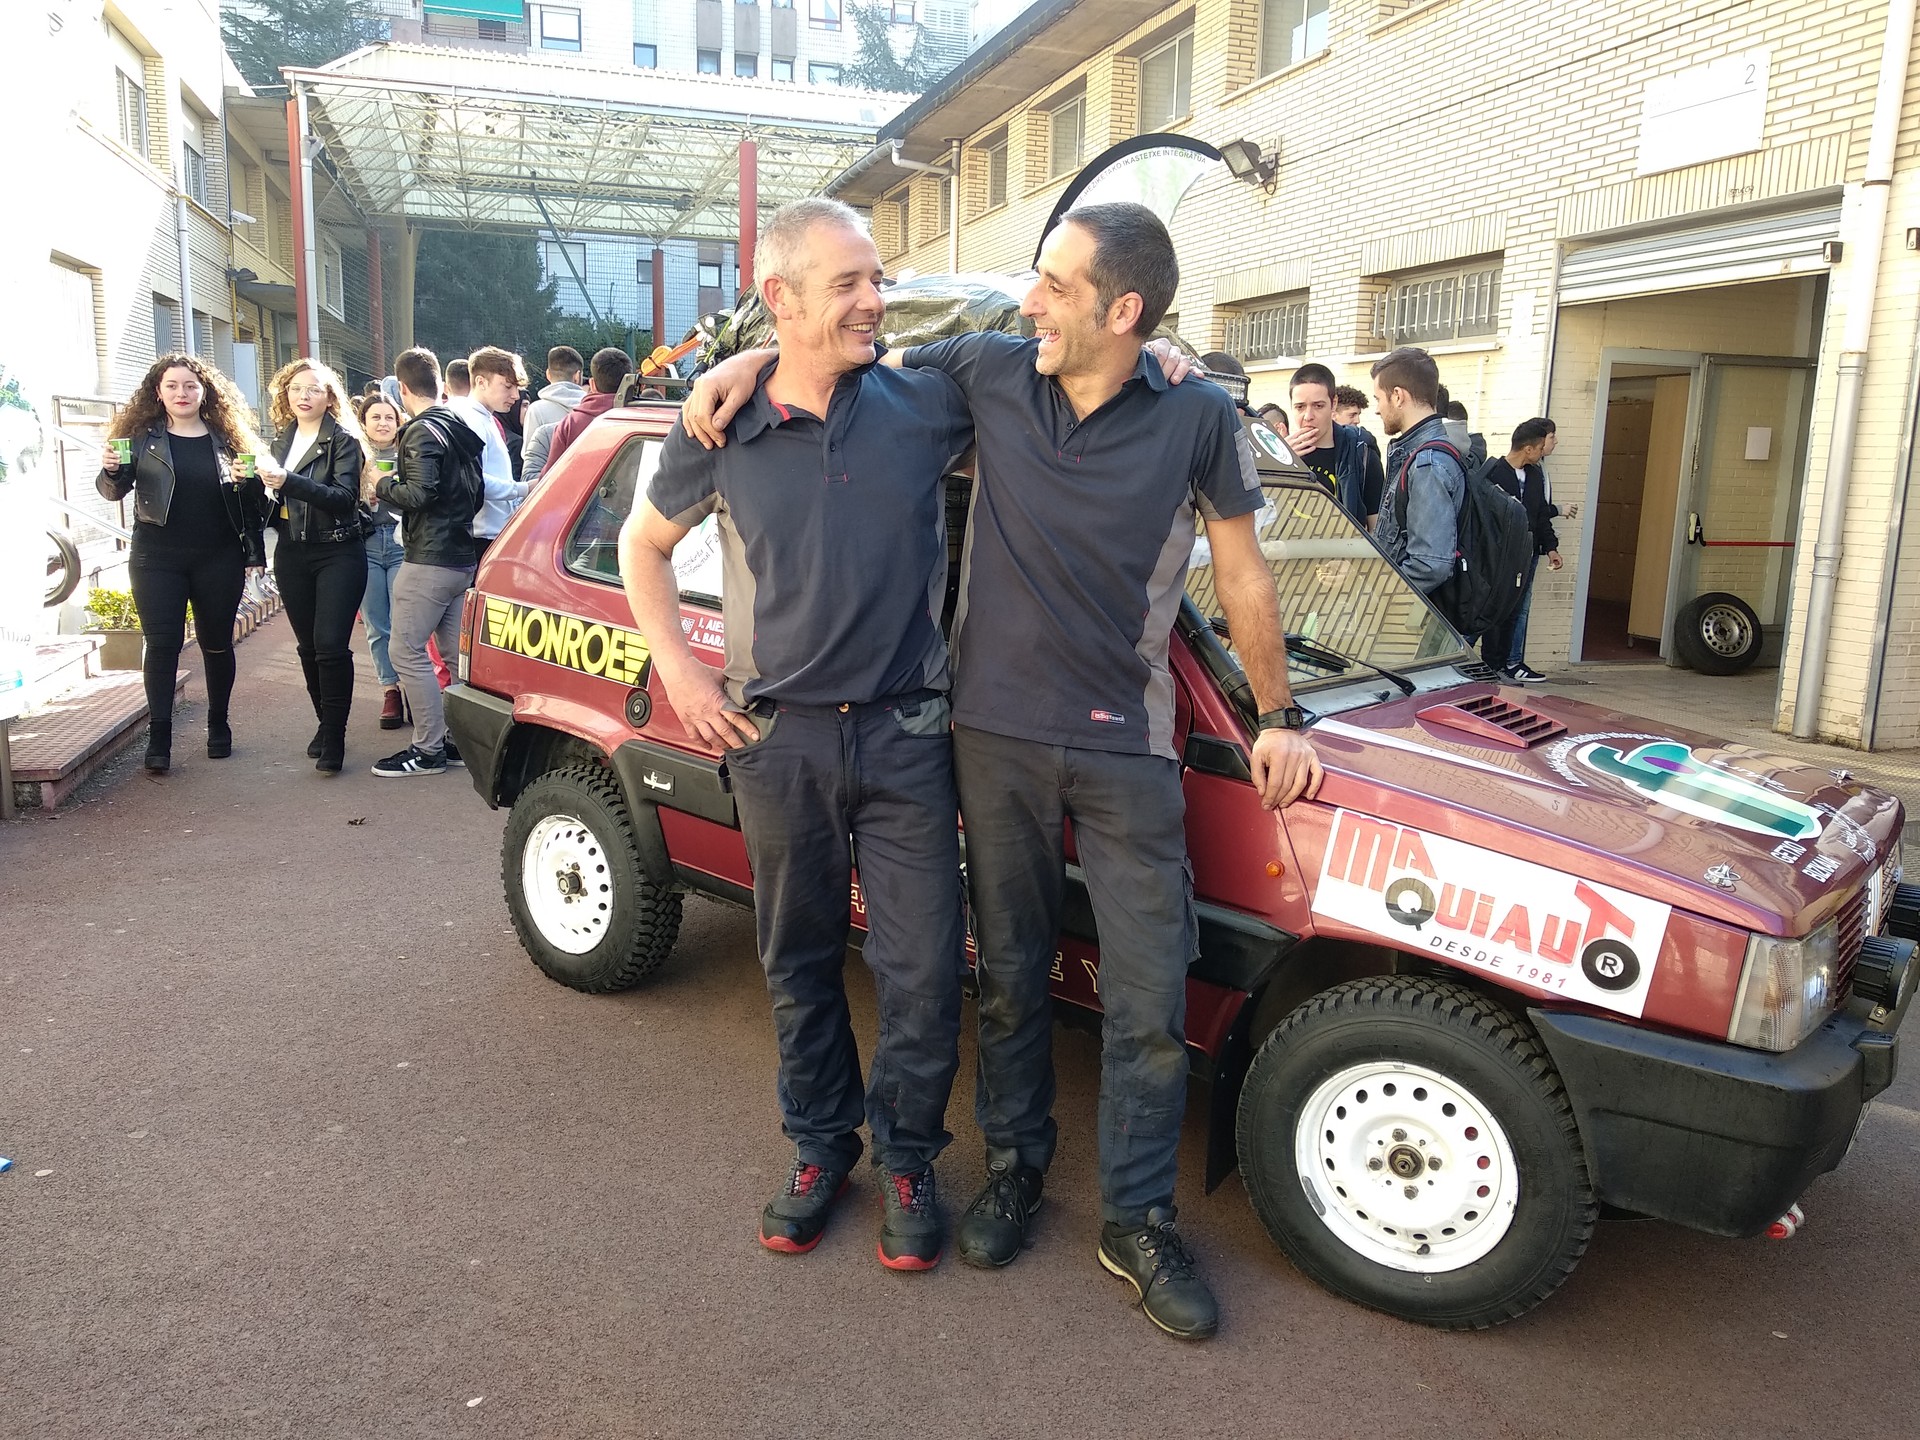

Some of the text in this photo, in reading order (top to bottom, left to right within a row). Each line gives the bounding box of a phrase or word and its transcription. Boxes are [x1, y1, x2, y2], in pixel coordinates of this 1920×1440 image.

[1744, 63, 1756, 85] 2
[1122, 150, 1162, 166] IKASTETXE
[1162, 149, 1206, 164] INTEGRATUA
[498, 604, 627, 682] MONROE
[690, 629, 701, 642] A.
[1770, 840, 1807, 864] GETXO
[1801, 853, 1842, 883] BIZKAIA
[1429, 935, 1568, 990] DESDE 1981
